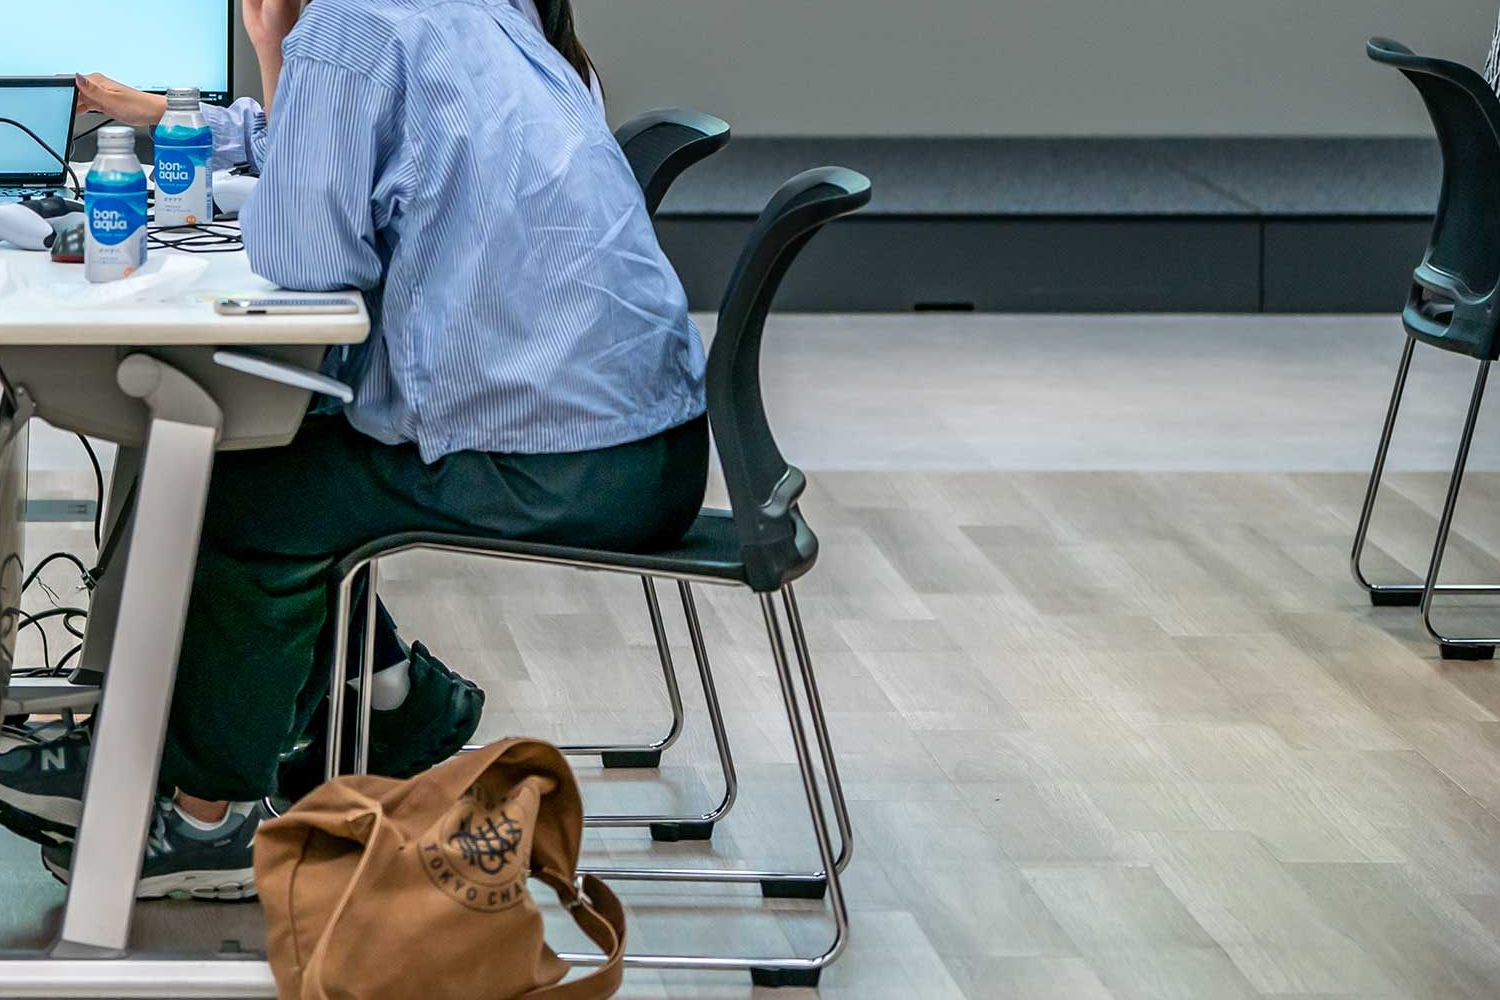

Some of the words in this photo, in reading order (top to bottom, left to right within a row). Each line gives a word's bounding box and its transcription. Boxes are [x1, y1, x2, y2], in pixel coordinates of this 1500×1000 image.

[159, 171, 188, 182] aqua
[93, 220, 127, 231] aqua
[424, 842, 478, 902] TOKYO
